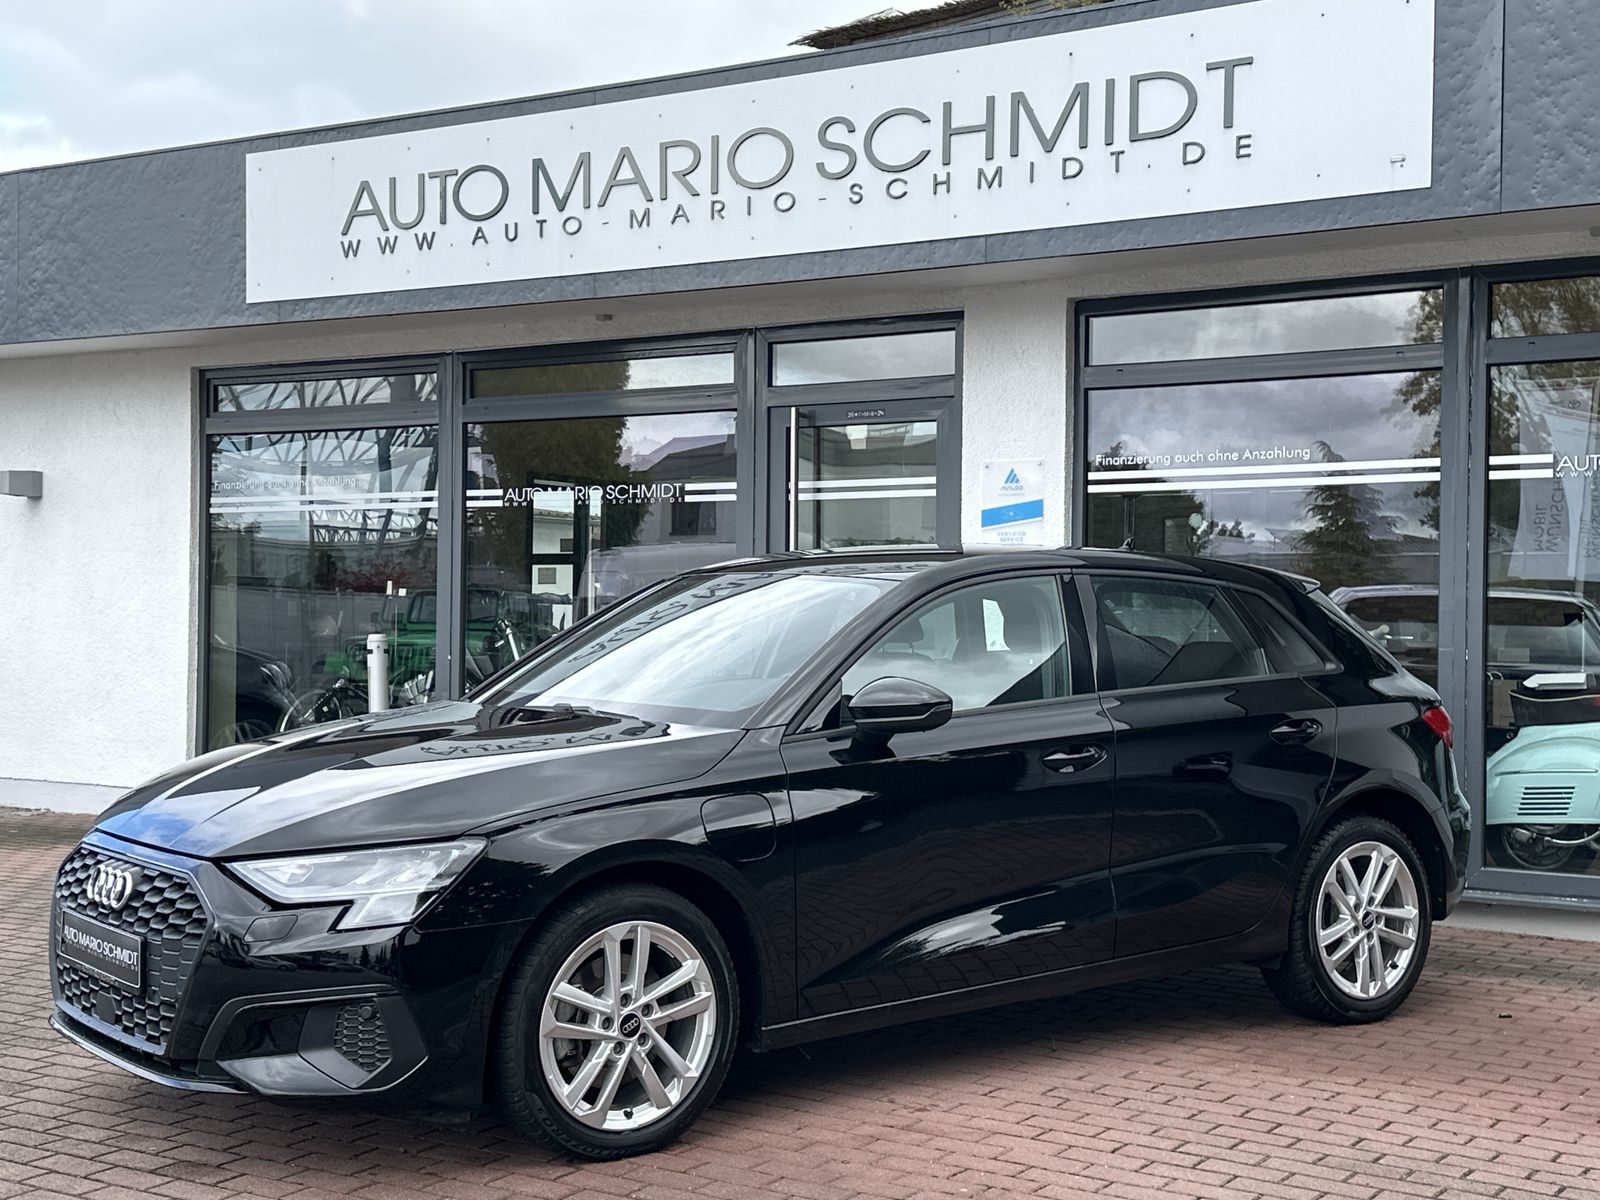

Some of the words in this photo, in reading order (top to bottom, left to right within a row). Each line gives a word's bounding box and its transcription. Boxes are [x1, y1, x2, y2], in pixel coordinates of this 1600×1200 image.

[341, 164, 509, 235] AUTO
[531, 127, 795, 215] MARIO
[816, 56, 1254, 180] SCHMIDT
[1095, 454, 1171, 466] Finanzierung
[1175, 449, 1204, 462] auch
[1208, 448, 1239, 460] ohne
[1243, 446, 1311, 460] Anzahlung
[606, 483, 683, 500] SCHMIDT
[64, 924, 79, 943] AUTO
[79, 931, 103, 953] MARIO
[103, 941, 138, 966] SCHMIDT
